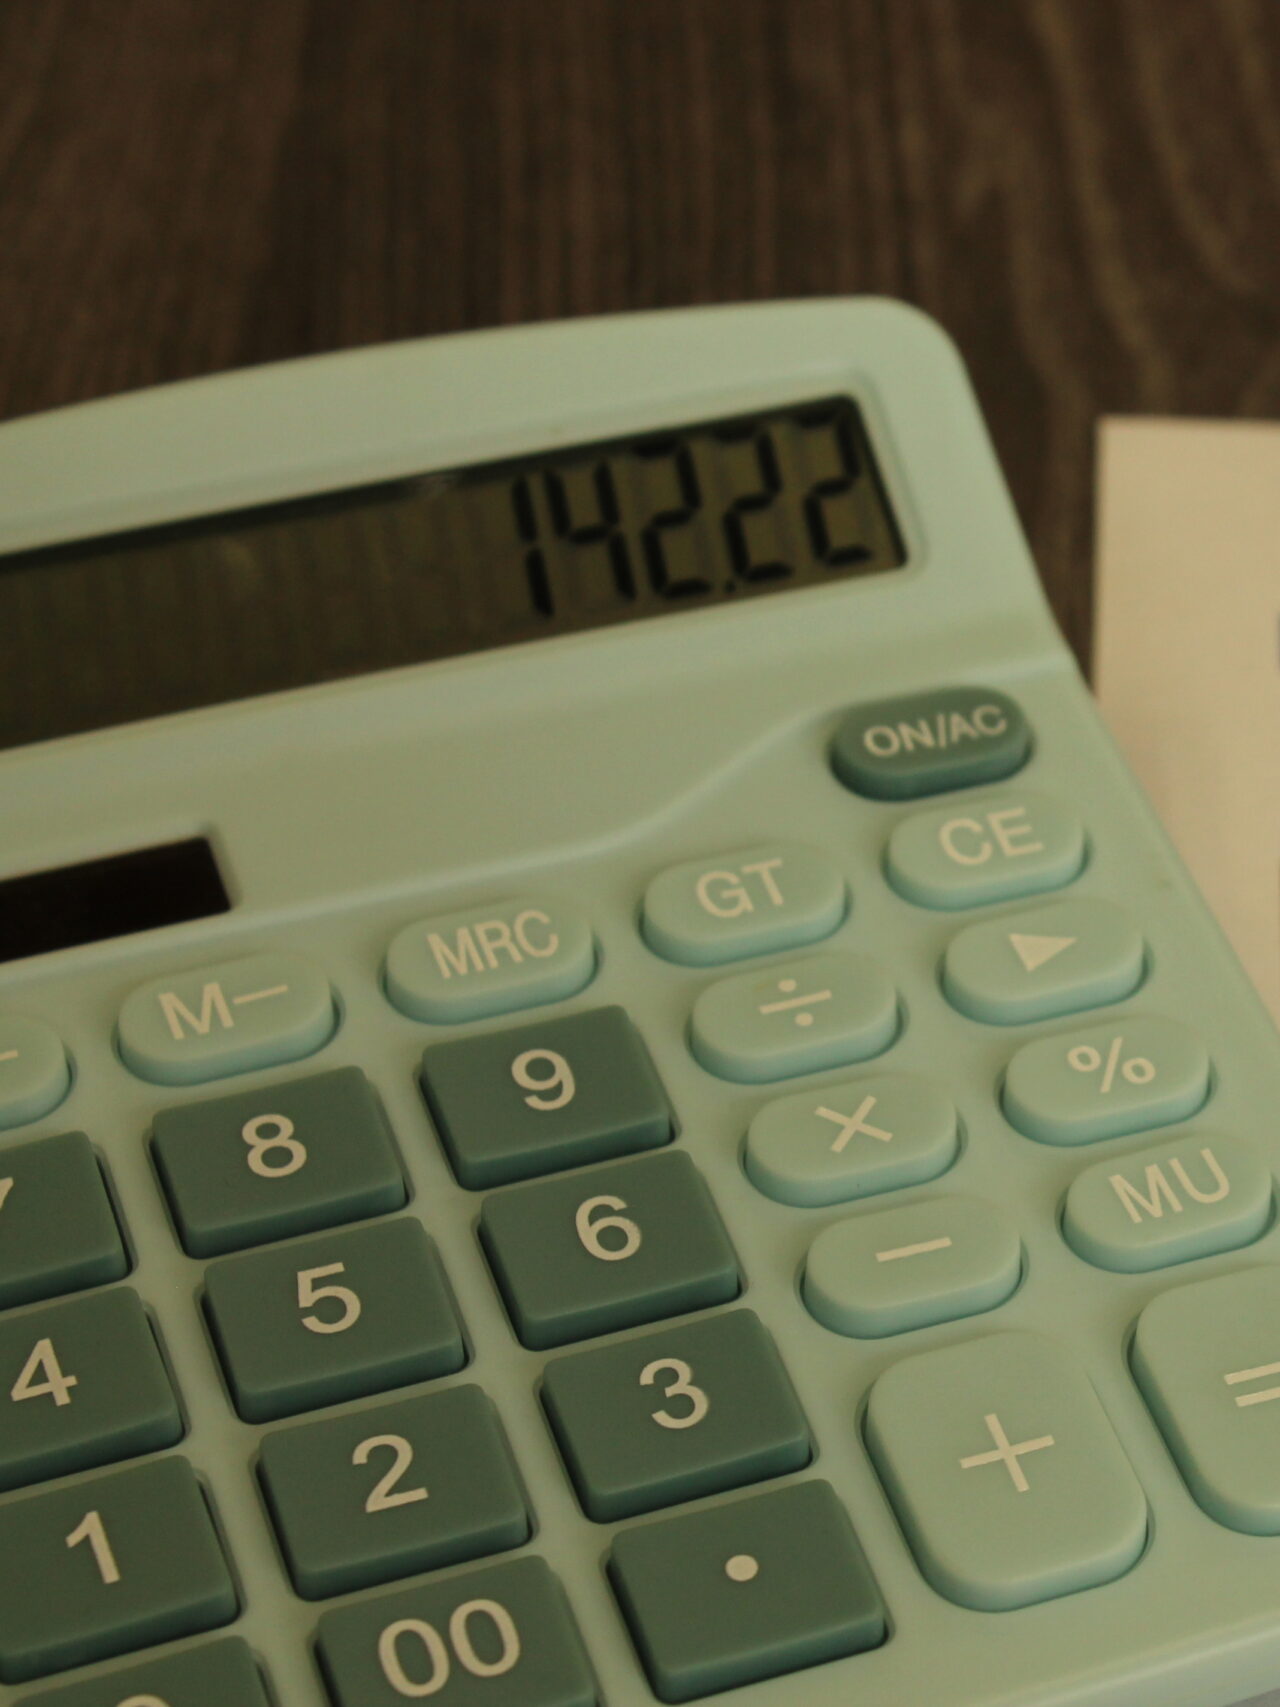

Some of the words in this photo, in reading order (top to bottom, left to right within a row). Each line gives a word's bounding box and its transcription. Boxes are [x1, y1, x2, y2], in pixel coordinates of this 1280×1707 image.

[511, 403, 871, 619] 142.22
[863, 704, 1008, 757] ON/AC
[938, 807, 1044, 865] CE
[695, 858, 784, 918] GT
[426, 909, 559, 979] MRC
[511, 1048, 576, 1110] 9
[1067, 1036, 1156, 1094] %
[241, 1114, 307, 1178] 8
[1108, 1147, 1230, 1224] MU
[574, 1195, 642, 1261] 6
[296, 1261, 361, 1334] 5
[10, 1338, 78, 1407] 4
[639, 1358, 710, 1430] 3
[351, 1434, 428, 1514] 2
[65, 1510, 120, 1584] 1
[378, 1599, 520, 1698] 00
